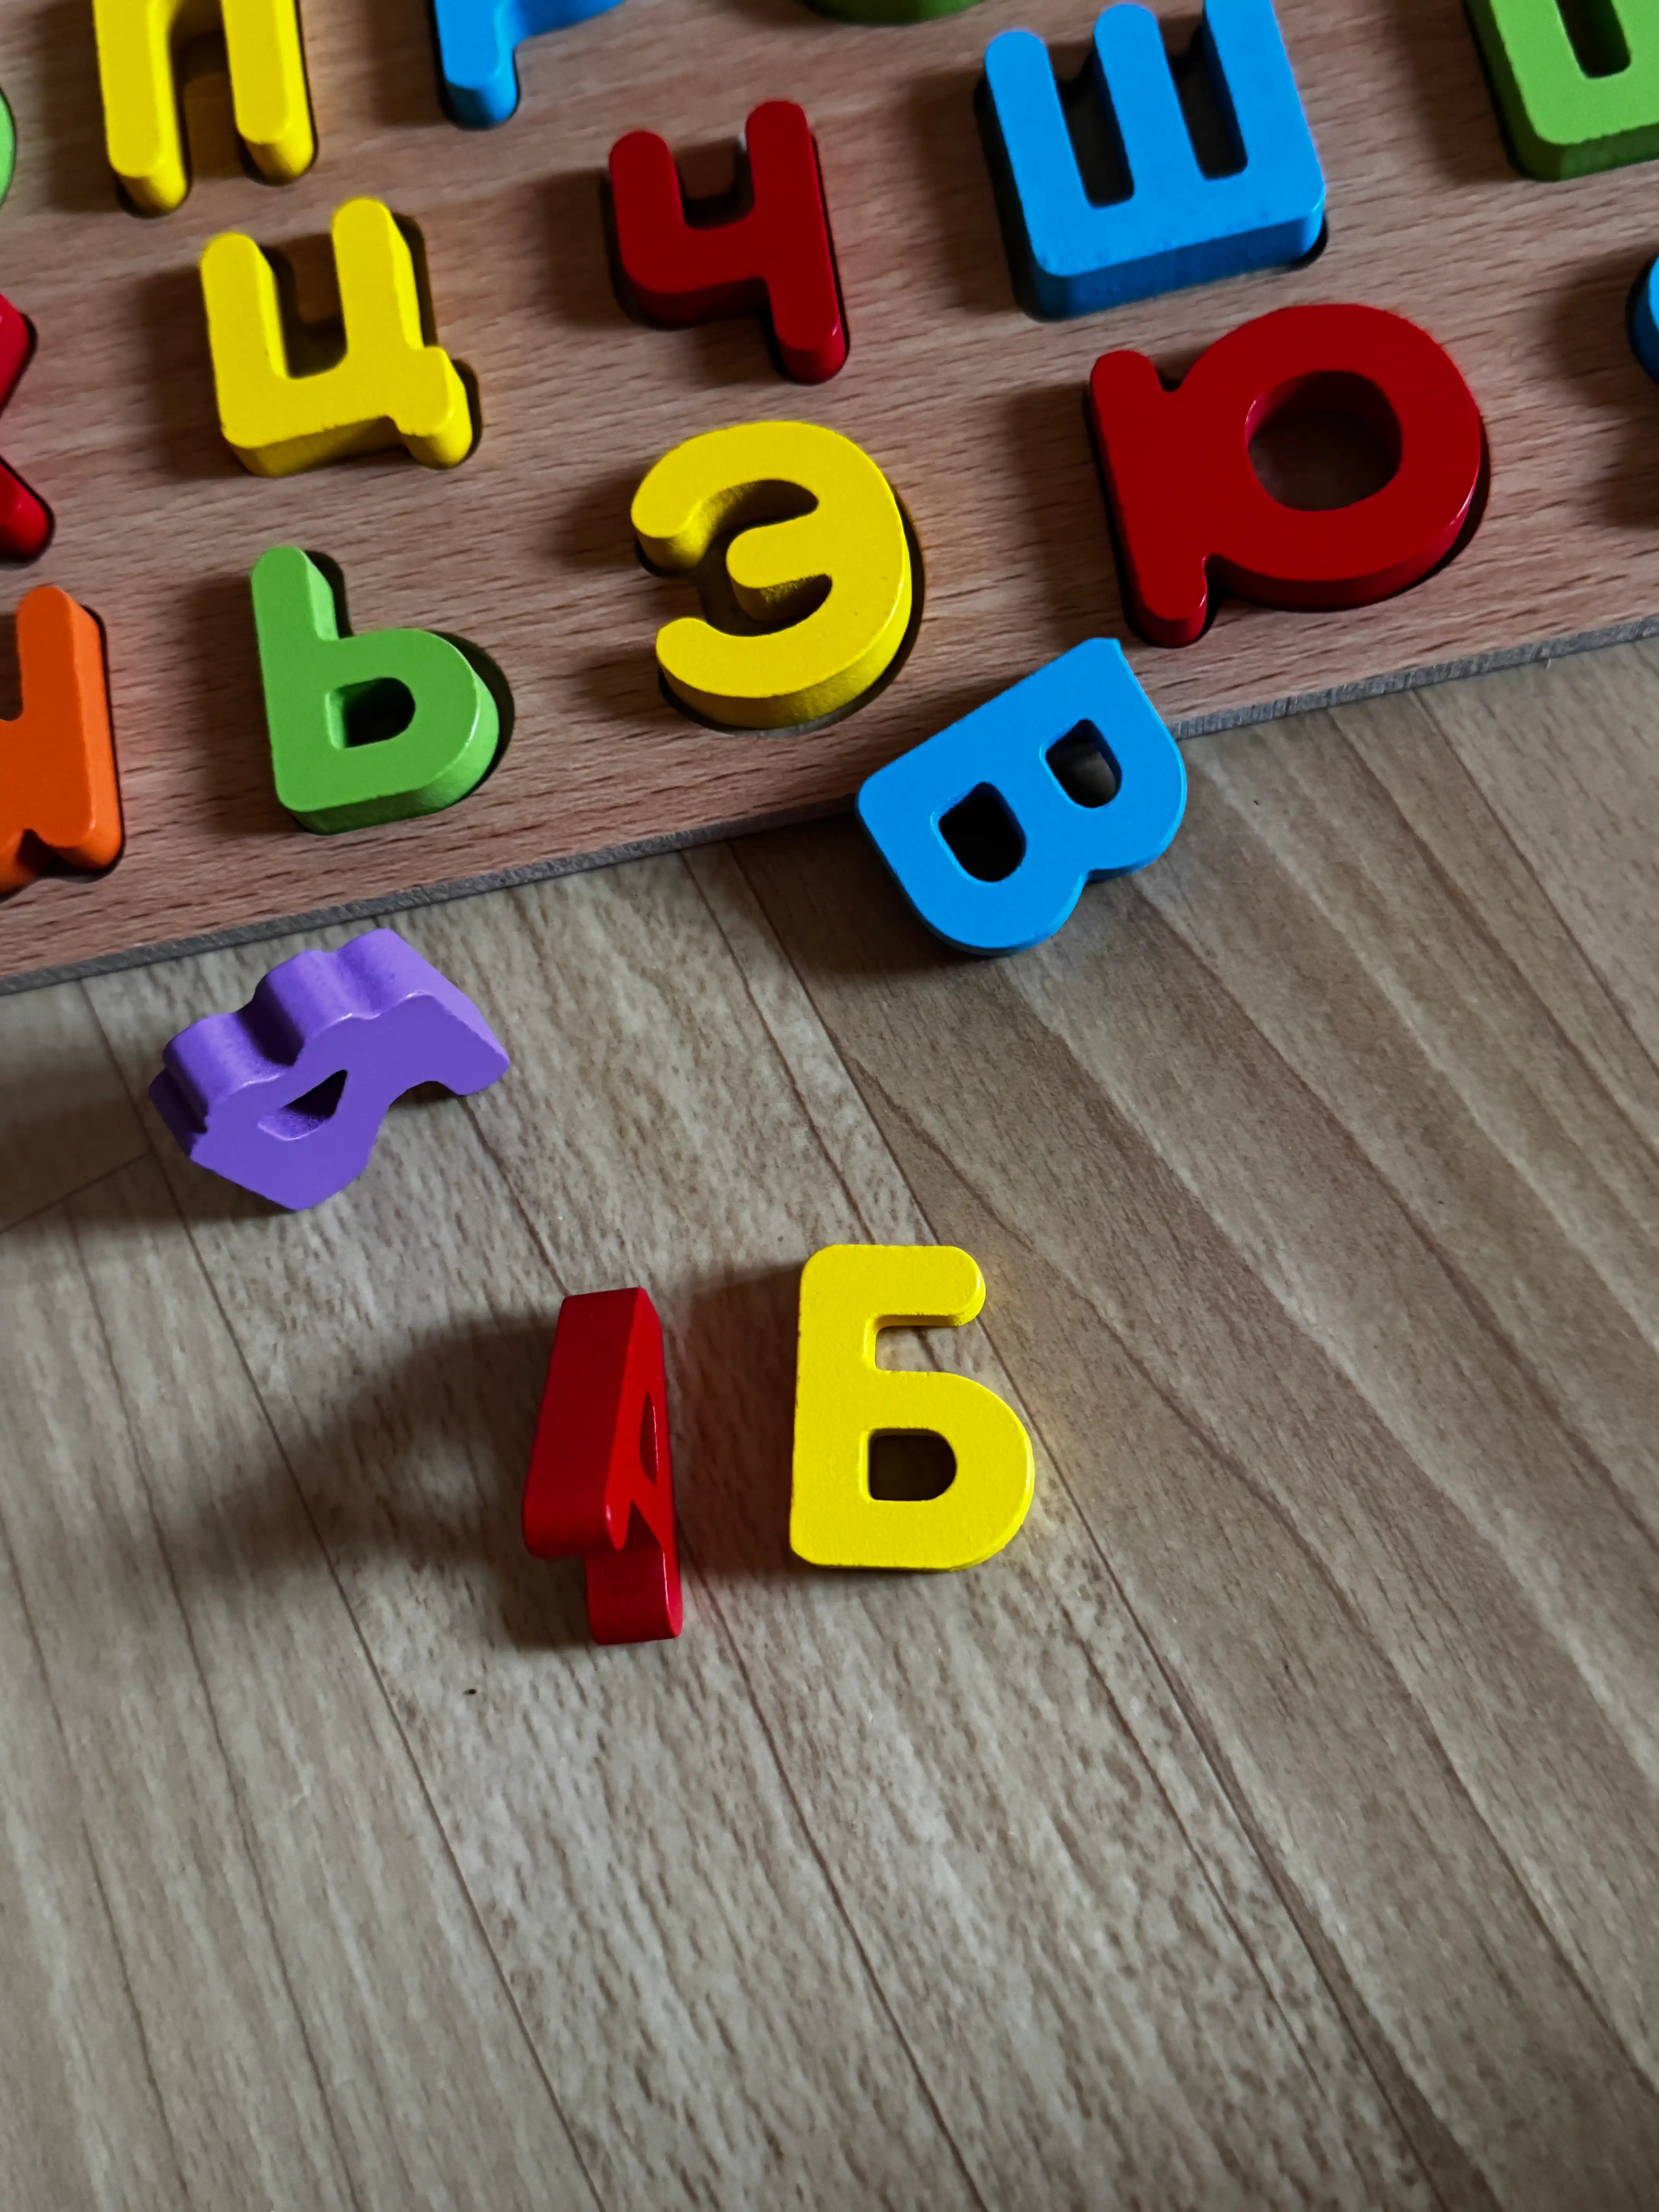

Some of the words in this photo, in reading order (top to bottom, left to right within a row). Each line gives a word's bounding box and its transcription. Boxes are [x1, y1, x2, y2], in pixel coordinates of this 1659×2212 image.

[200, 198, 473, 477] Ц
[609, 100, 850, 380] Ч
[984, 0, 1326, 318] Ш
[630, 421, 912, 728] Э
[1090, 304, 1485, 647] Ю
[789, 1244, 1034, 1571] Б
